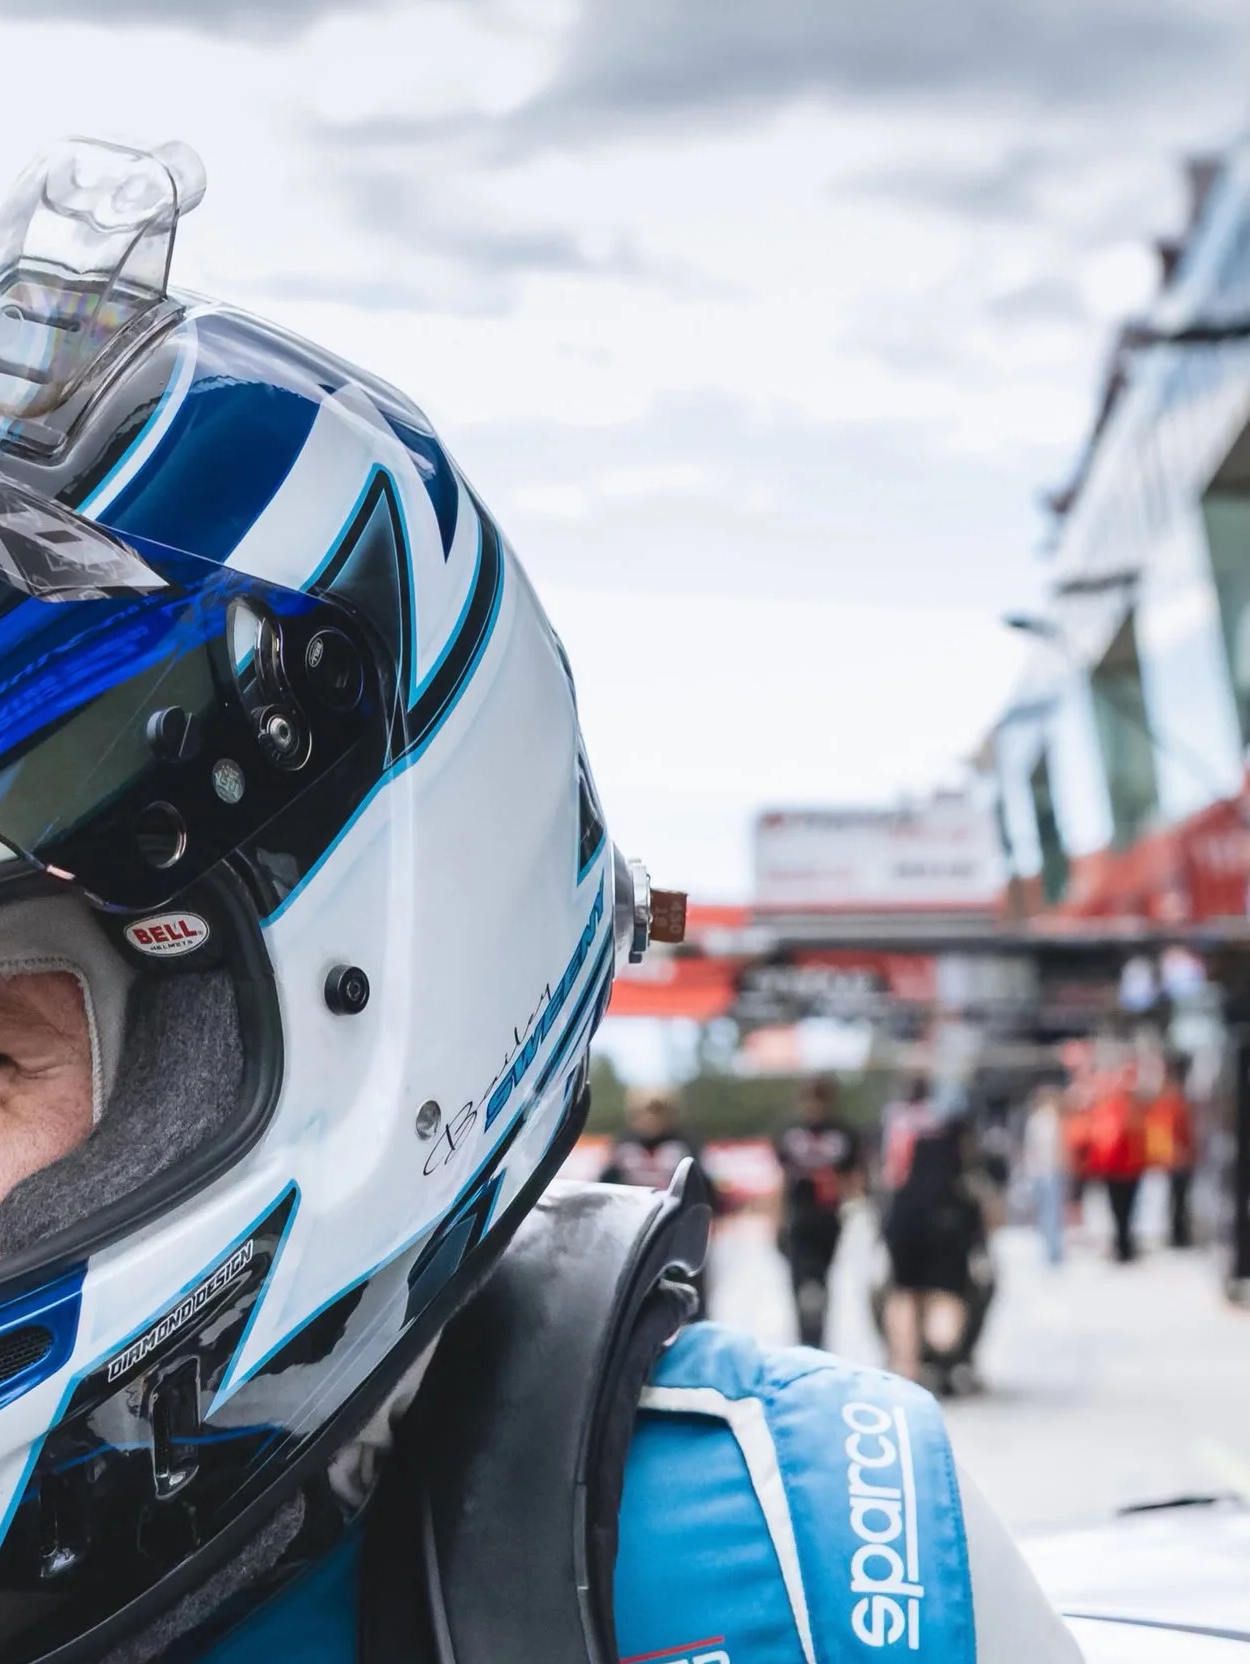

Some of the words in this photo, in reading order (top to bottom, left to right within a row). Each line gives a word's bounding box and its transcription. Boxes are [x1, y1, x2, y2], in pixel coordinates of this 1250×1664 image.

[132, 919, 198, 945] BELL
[150, 939, 194, 952] HELMETS
[107, 1296, 194, 1384] DIAMOND
[193, 1238, 254, 1313] DESIGN
[841, 1401, 925, 1650] sparco
